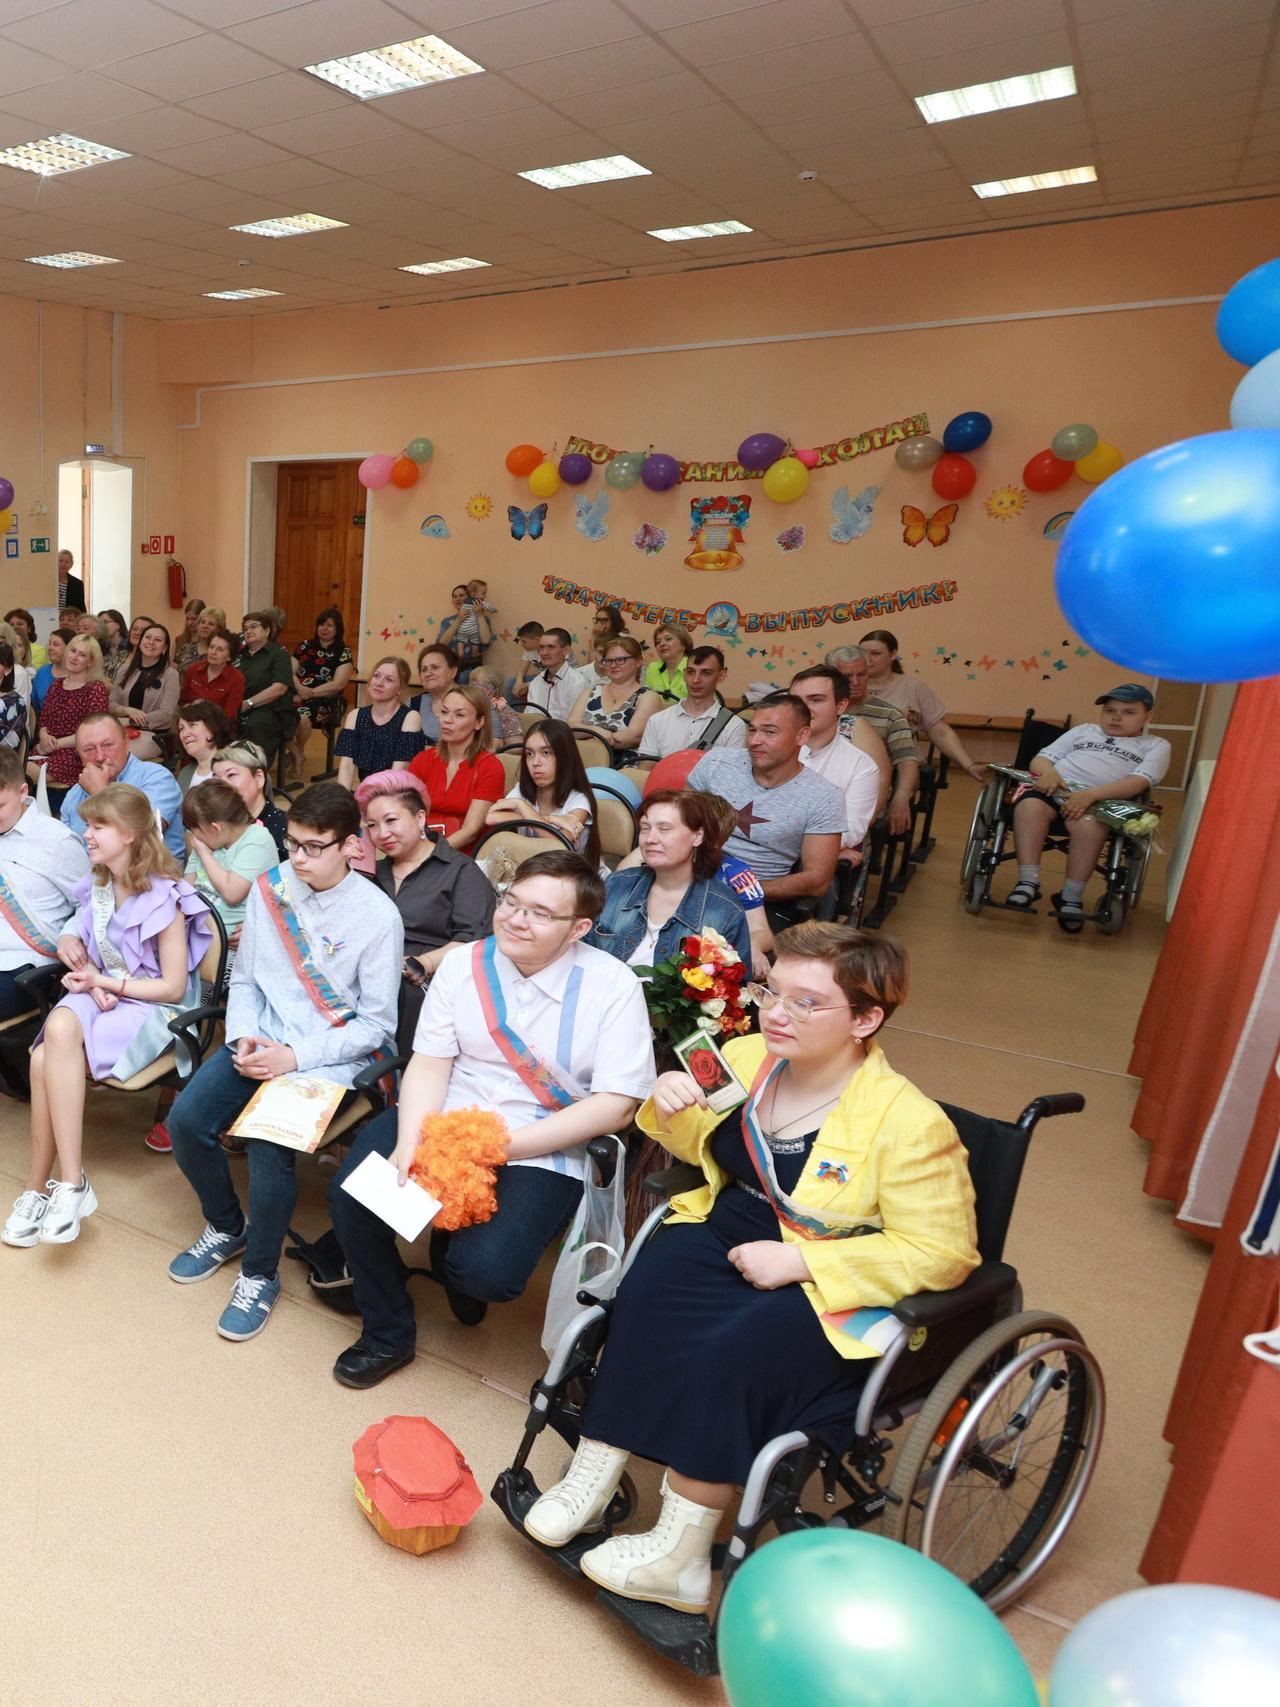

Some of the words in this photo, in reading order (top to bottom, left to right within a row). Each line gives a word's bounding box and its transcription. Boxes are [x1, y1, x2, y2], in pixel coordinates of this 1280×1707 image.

[813, 418, 919, 467] КОЛА!
[548, 576, 623, 609] УДАЧИ
[746, 580, 955, 631] ВЫПУСКНИК!
